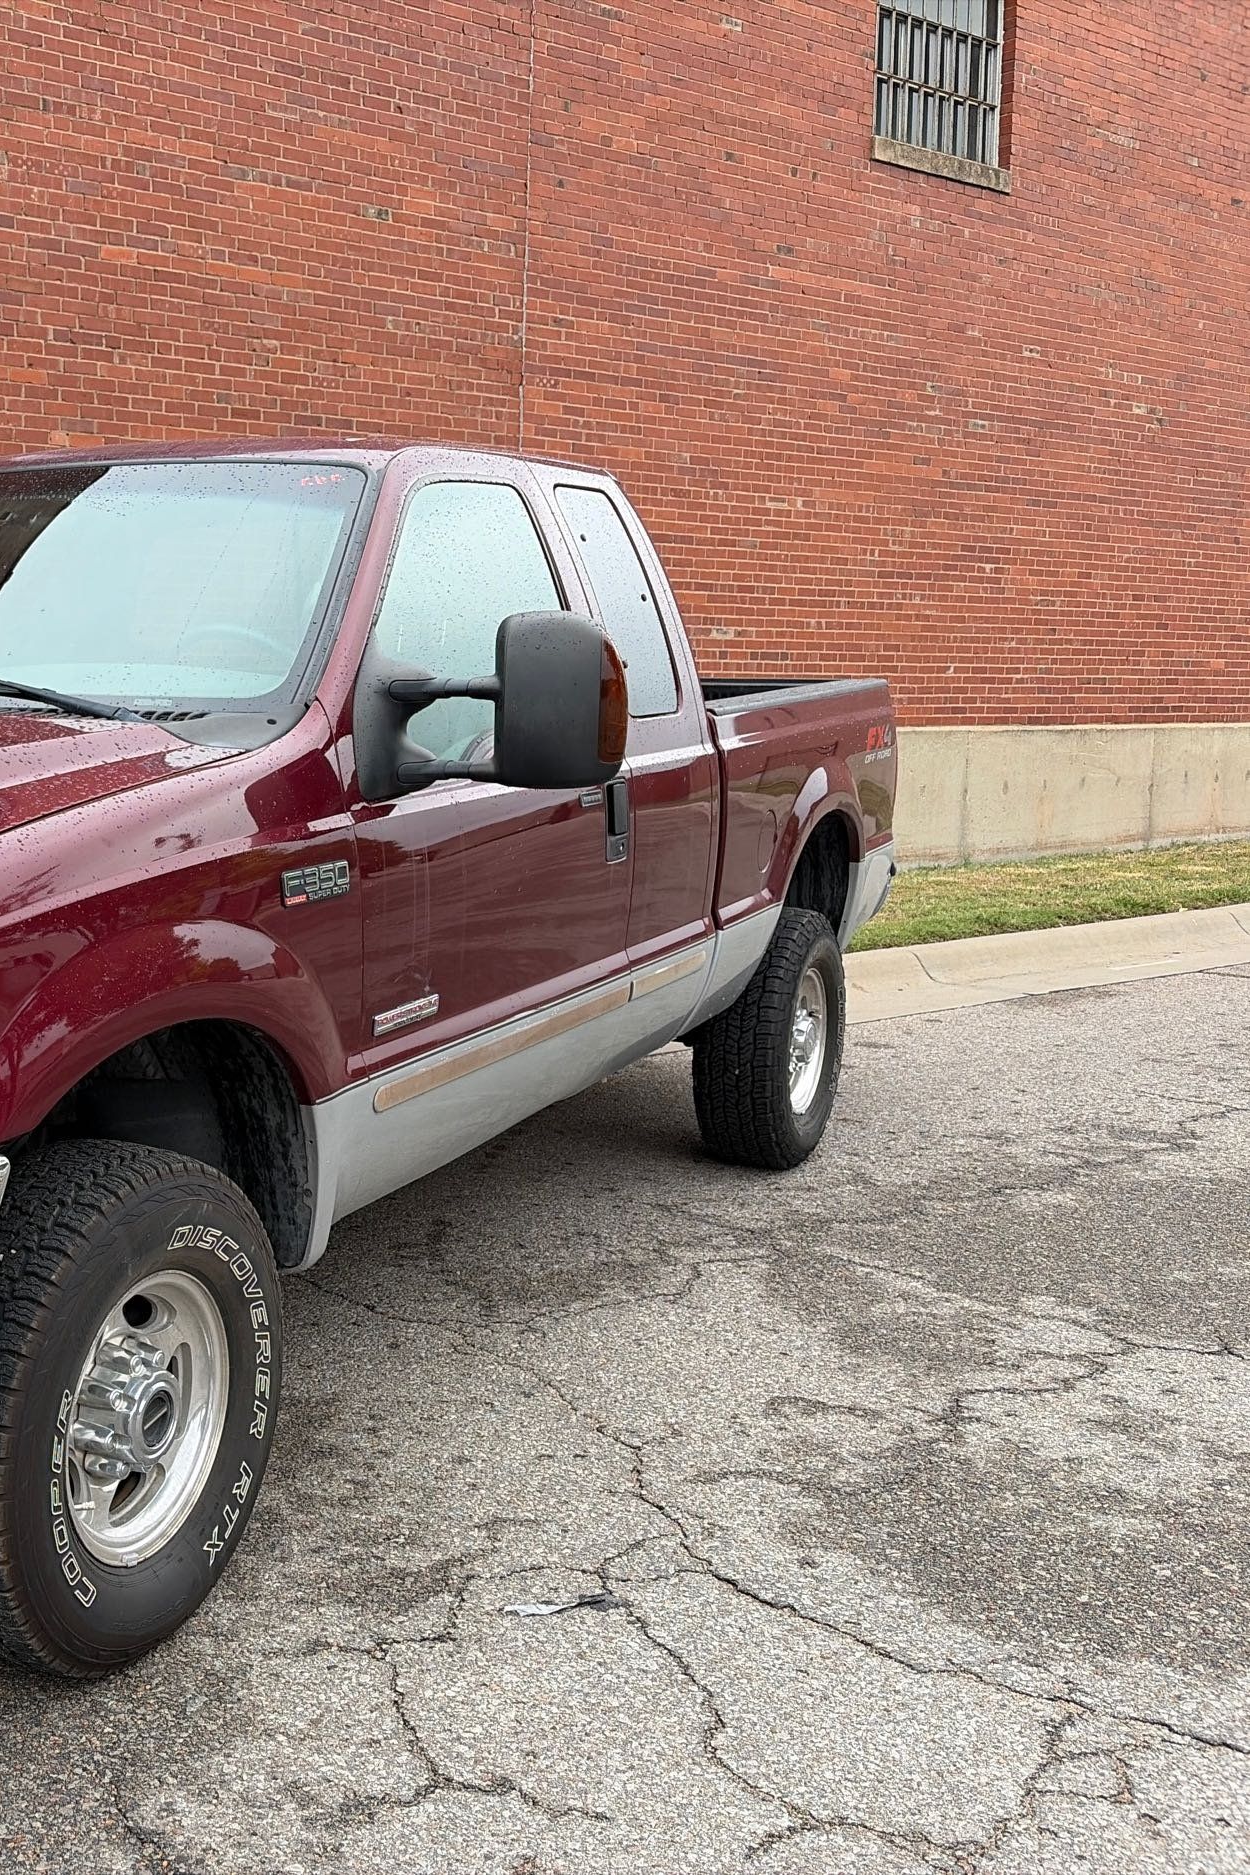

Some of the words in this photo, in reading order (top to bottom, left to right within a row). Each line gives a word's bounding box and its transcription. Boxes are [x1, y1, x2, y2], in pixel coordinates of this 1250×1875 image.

[864, 752, 876, 764] OFF
[877, 748, 892, 761] ROAD
[866, 724, 892, 752] FX4
[308, 888, 332, 901] SUPER
[332, 884, 350, 895] DUTY
[166, 1225, 272, 1440] DISCOVERER
[50, 1389, 97, 1608] COOPER
[202, 1461, 253, 1566] RTX
